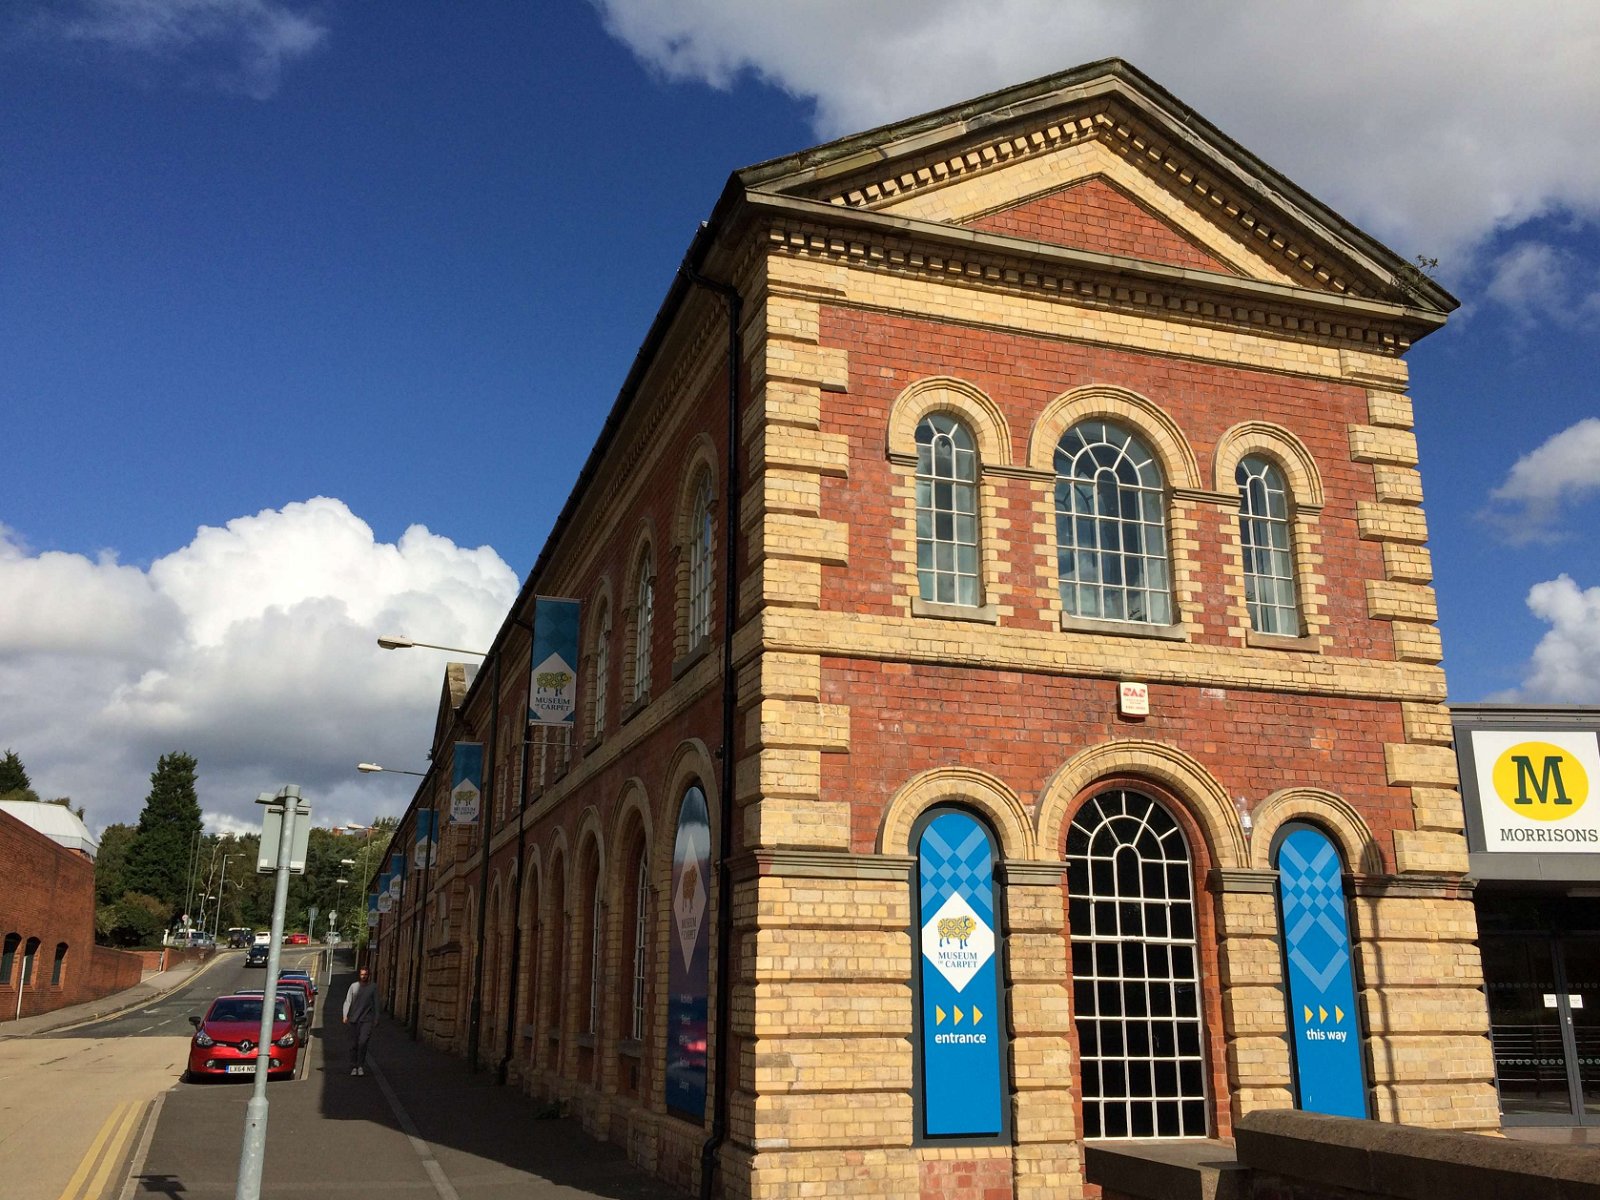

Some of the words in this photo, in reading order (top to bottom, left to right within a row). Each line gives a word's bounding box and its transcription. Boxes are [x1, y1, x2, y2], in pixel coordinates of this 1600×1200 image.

[535, 697, 570, 705] MUSEUM
[1511, 755, 1573, 805] M
[1500, 828, 1599, 842] MORRISONS
[938, 952, 978, 960] MUSEUM
[935, 1032, 987, 1044] entrance
[1306, 1028, 1326, 1040] this
[1327, 1031, 1347, 1043] way
